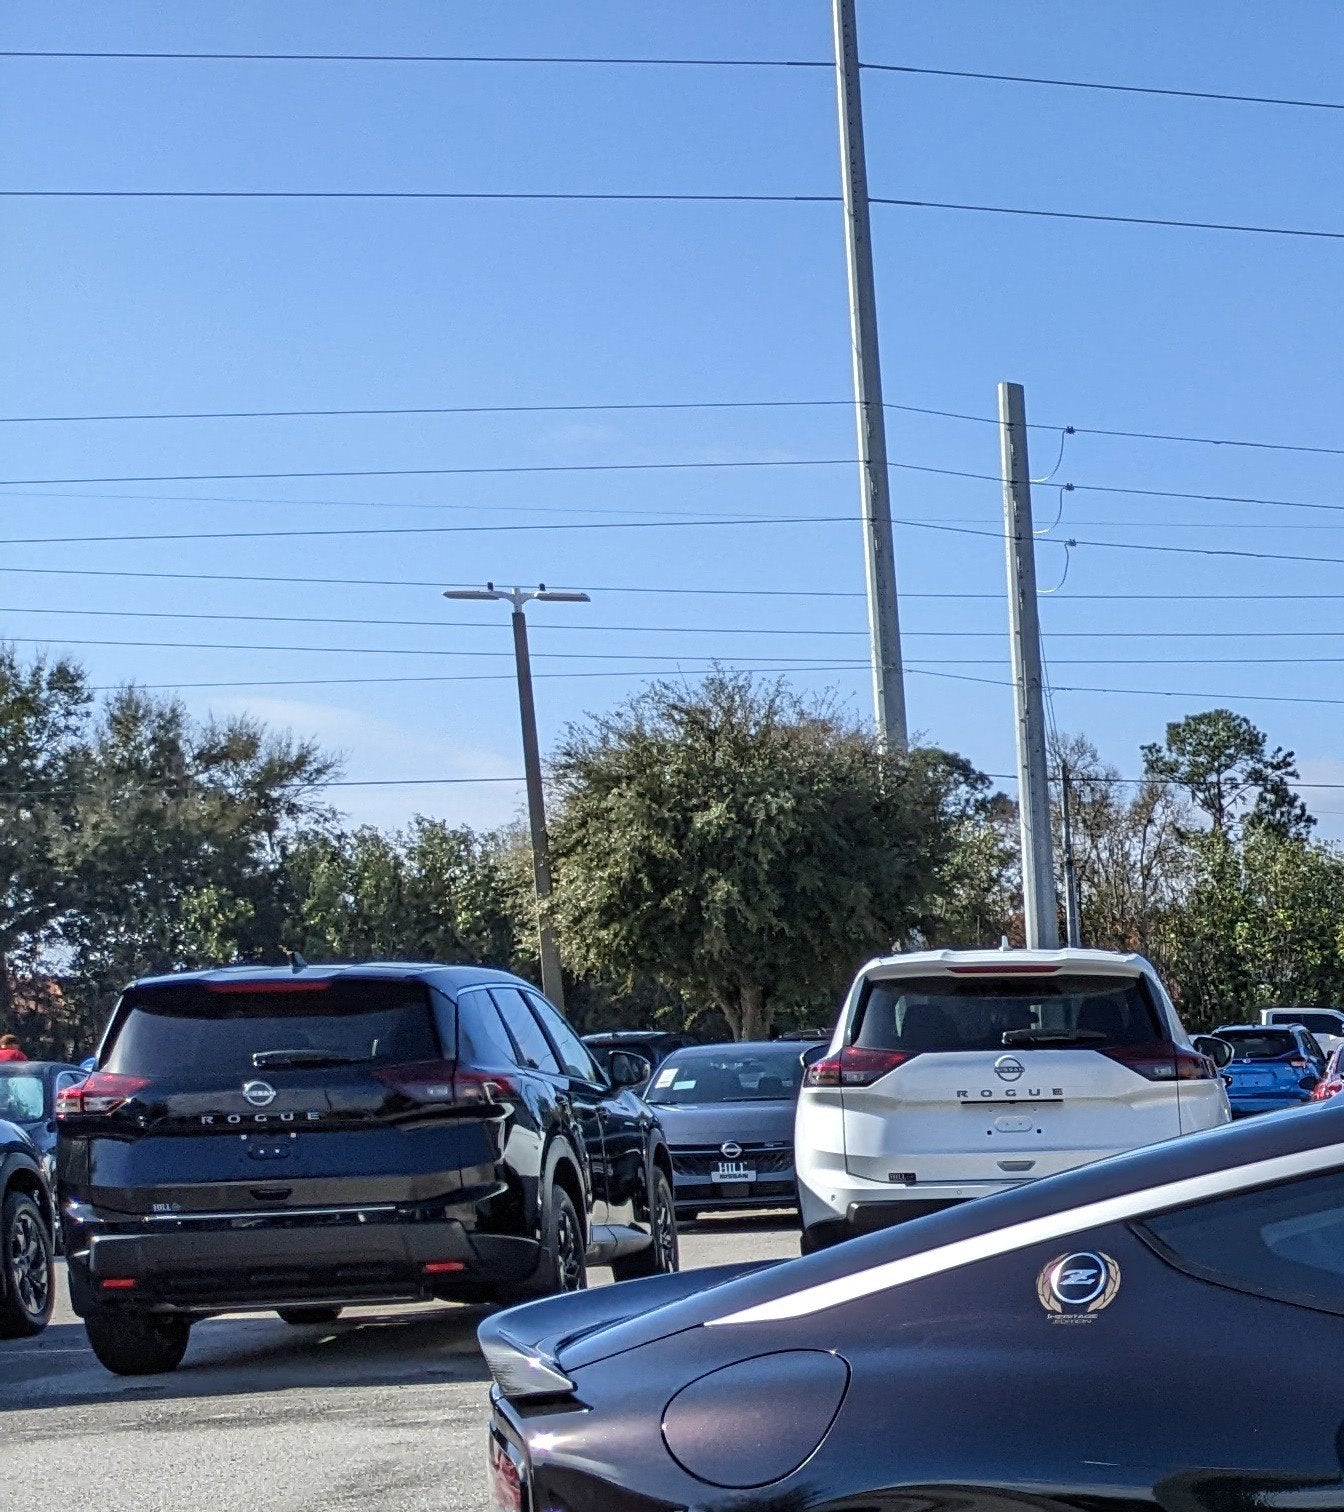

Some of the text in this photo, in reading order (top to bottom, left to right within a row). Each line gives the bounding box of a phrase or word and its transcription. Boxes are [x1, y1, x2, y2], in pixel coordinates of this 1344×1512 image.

[957, 1088, 1063, 1098] ROGUE
[201, 1111, 320, 1125] ROGUE
[718, 1162, 747, 1174] HILL
